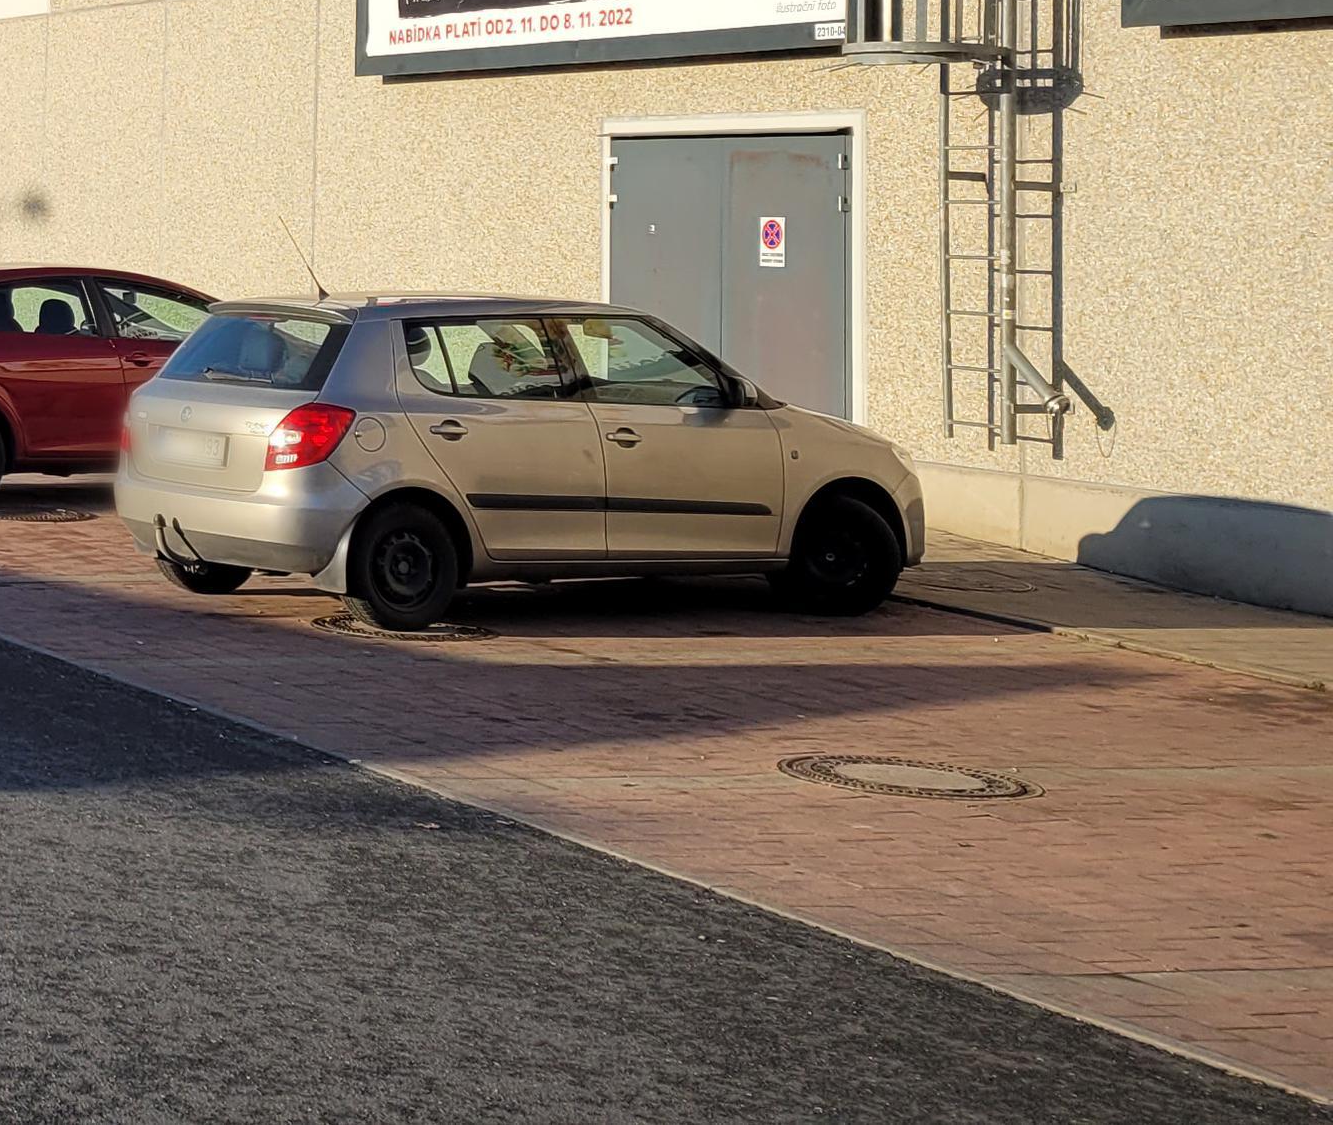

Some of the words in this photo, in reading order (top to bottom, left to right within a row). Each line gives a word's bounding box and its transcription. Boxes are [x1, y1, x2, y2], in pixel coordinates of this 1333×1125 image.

[389, 24, 441, 46] NABÍDKA
[445, 17, 482, 39] PLATÍ
[485, 19, 504, 35] OD
[505, 18, 517, 34] 2.
[520, 16, 536, 33] 11.
[540, 13, 560, 32] DO
[563, 13, 575, 29] 8.
[578, 10, 595, 27] 11.
[599, 7, 633, 26] 2022
